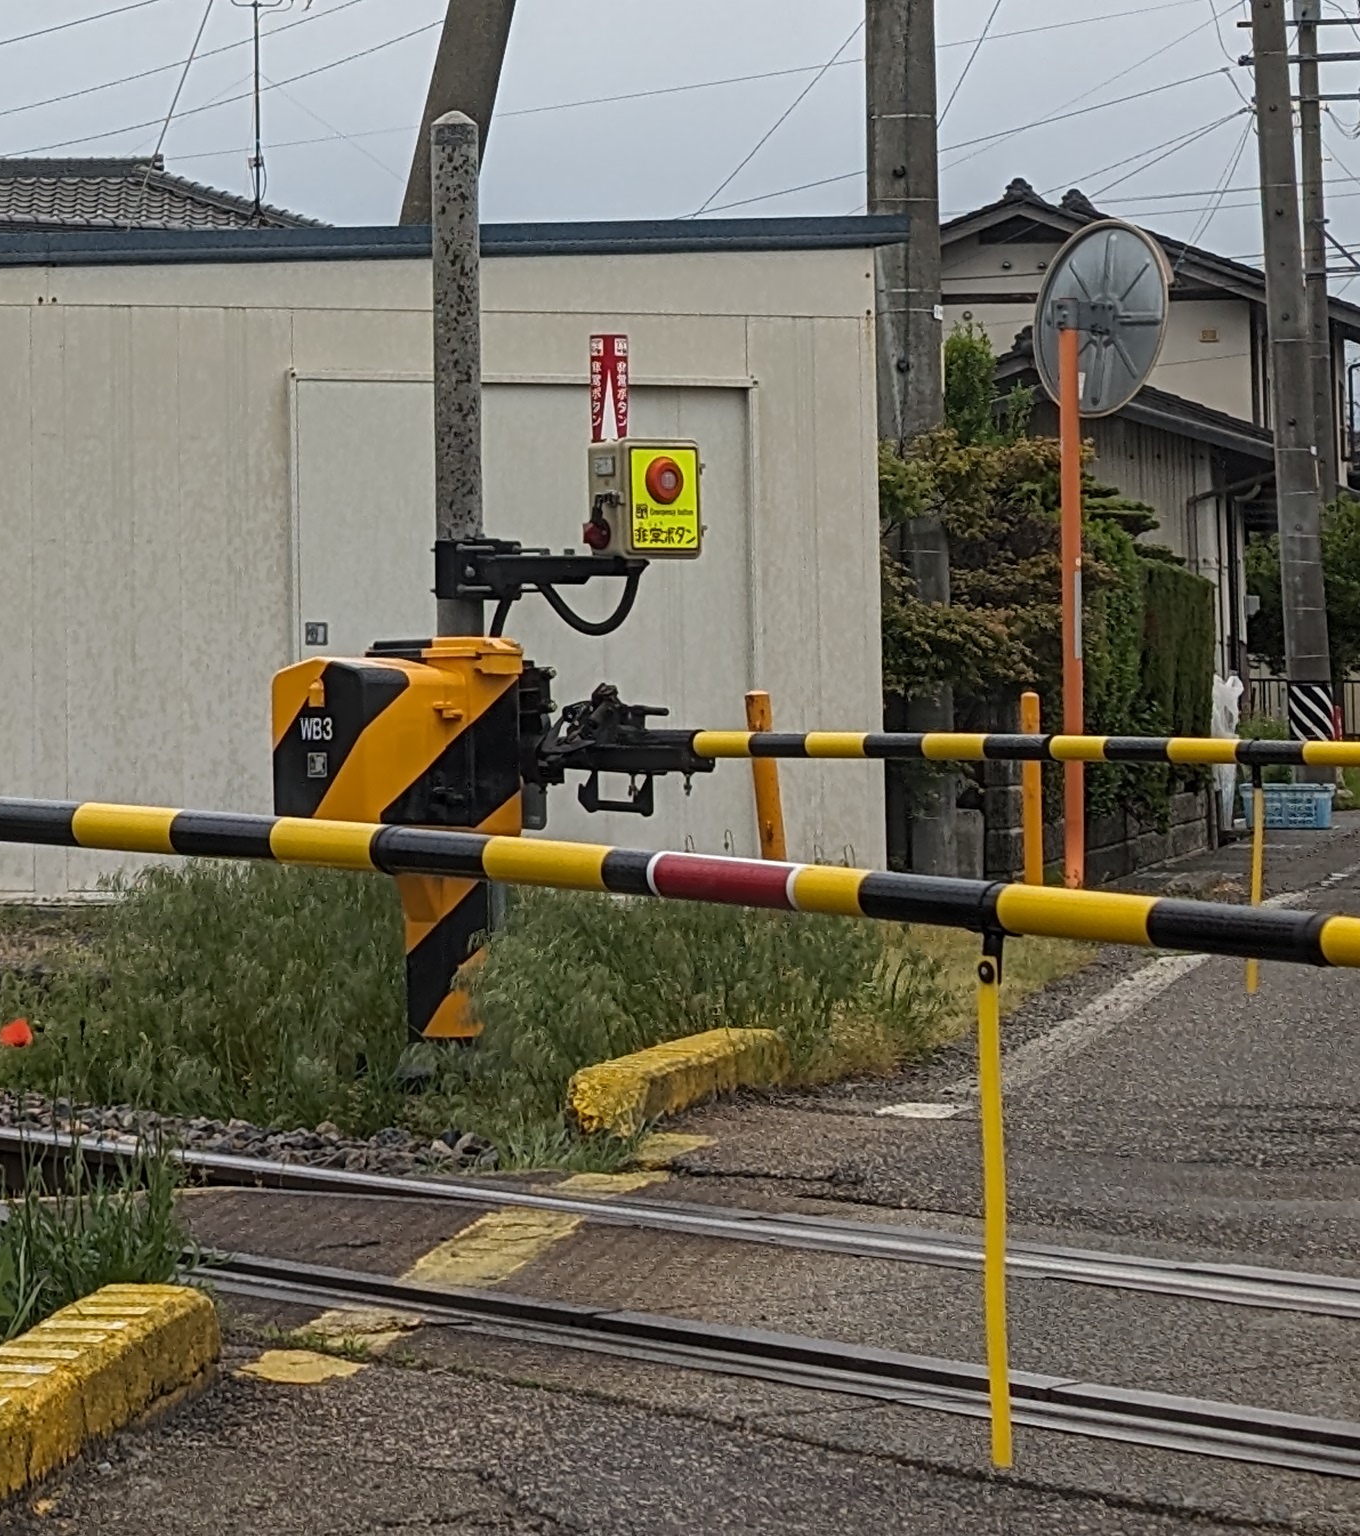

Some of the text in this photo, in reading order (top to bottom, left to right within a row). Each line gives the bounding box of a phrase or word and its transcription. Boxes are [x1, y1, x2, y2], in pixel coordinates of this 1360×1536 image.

[634, 526, 697, 544] 非常ボタン
[300, 717, 333, 741] WB3
